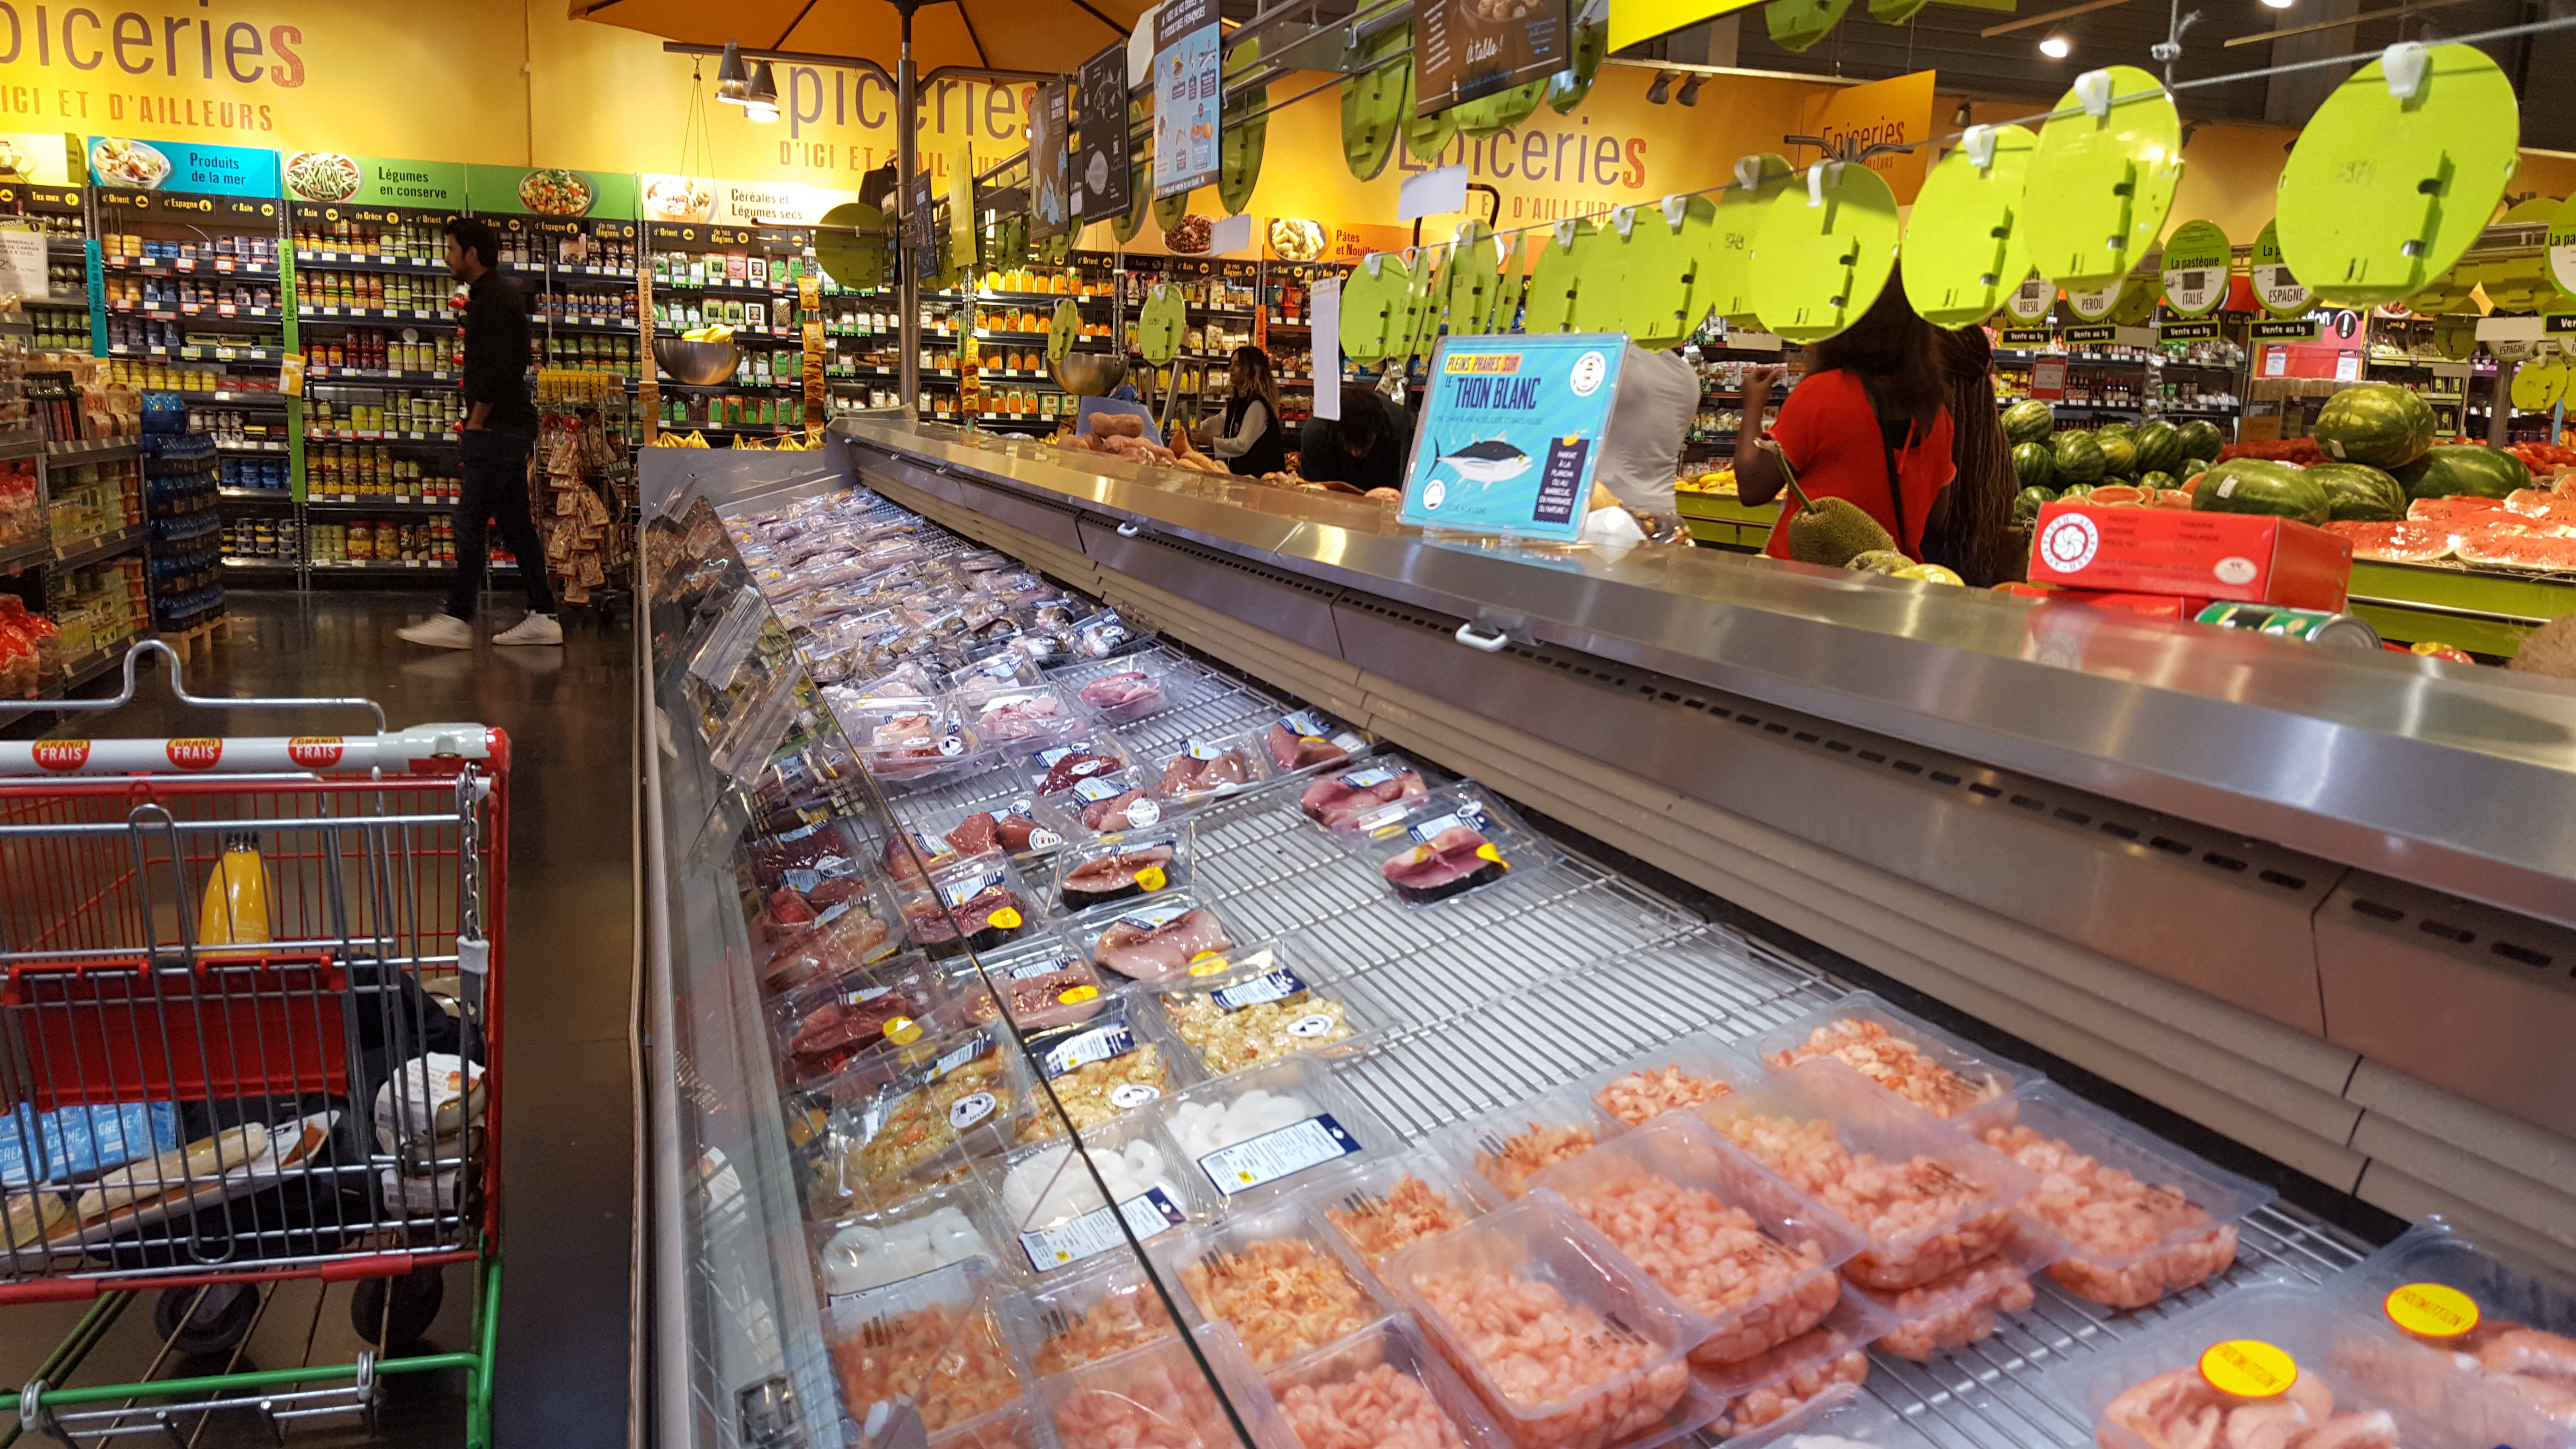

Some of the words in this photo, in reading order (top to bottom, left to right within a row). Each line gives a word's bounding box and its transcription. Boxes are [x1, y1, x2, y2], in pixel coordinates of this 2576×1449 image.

[59, 89, 88, 118] ET
[110, 93, 273, 131] D'AILLEURS
[190, 152, 240, 170] Produits
[780, 141, 834, 169] D'ICI
[850, 146, 873, 171] ET
[192, 170, 206, 184] de
[209, 171, 220, 184] la
[223, 174, 246, 186] mer
[378, 166, 429, 185] Légumes
[32, 192, 44, 201] Tex
[380, 186, 393, 196] en
[397, 187, 447, 199] conserve
[731, 189, 777, 205] Céréales
[781, 194, 789, 204] et
[109, 194, 129, 204] Orient
[171, 198, 198, 209] Espagne
[240, 204, 253, 212] Asie
[304, 209, 318, 217] Asie
[731, 203, 776, 218] Légumes
[781, 211, 803, 220] secs
[364, 211, 382, 221] Grèce
[423, 215, 441, 224] Orient
[488, 219, 500, 228] Asie
[541, 222, 565, 231] Espagne
[596, 228, 619, 238] Régions
[660, 228, 678, 237] Orient
[1336, 229, 1360, 242] Pâtes
[711, 234, 734, 243] Régions
[2550, 233, 2560, 246] La
[1336, 245, 1344, 255] et
[2263, 245, 2272, 256] La
[1083, 257, 1098, 265] Orient
[2171, 258, 2179, 269] La
[2182, 256, 2219, 270] pastèque
[2183, 292, 2203, 305] ITALIE
[2269, 288, 2304, 303] ESPAGNE
[286, 291, 295, 321] Légumes
[642, 293, 651, 322] Légumes
[2019, 301, 2039, 312] BRESIL
[2082, 298, 2103, 310] PEROU
[2101, 330, 2109, 339] kg
[2171, 328, 2190, 336] Vente
[2202, 326, 2210, 336] kg
[2261, 325, 2283, 334] Vente
[2297, 324, 2305, 335] kg
[2037, 333, 2044, 342] kg
[643, 332, 652, 360] Céréales
[2499, 344, 2526, 355] ESPAGNE
[1447, 357, 1472, 371] PLEINS
[1472, 357, 1502, 371] PHARES
[1501, 357, 1520, 371] SUR
[1445, 376, 1453, 388] LE
[1455, 377, 1493, 409] THON
[1492, 377, 1542, 410] BLANC
[41, 740, 83, 749] GRAND
[175, 739, 216, 747] GRAND
[40, 746, 81, 761] FRAIS
[174, 746, 214, 760] FRAIS
[296, 744, 336, 760] FRAIS
